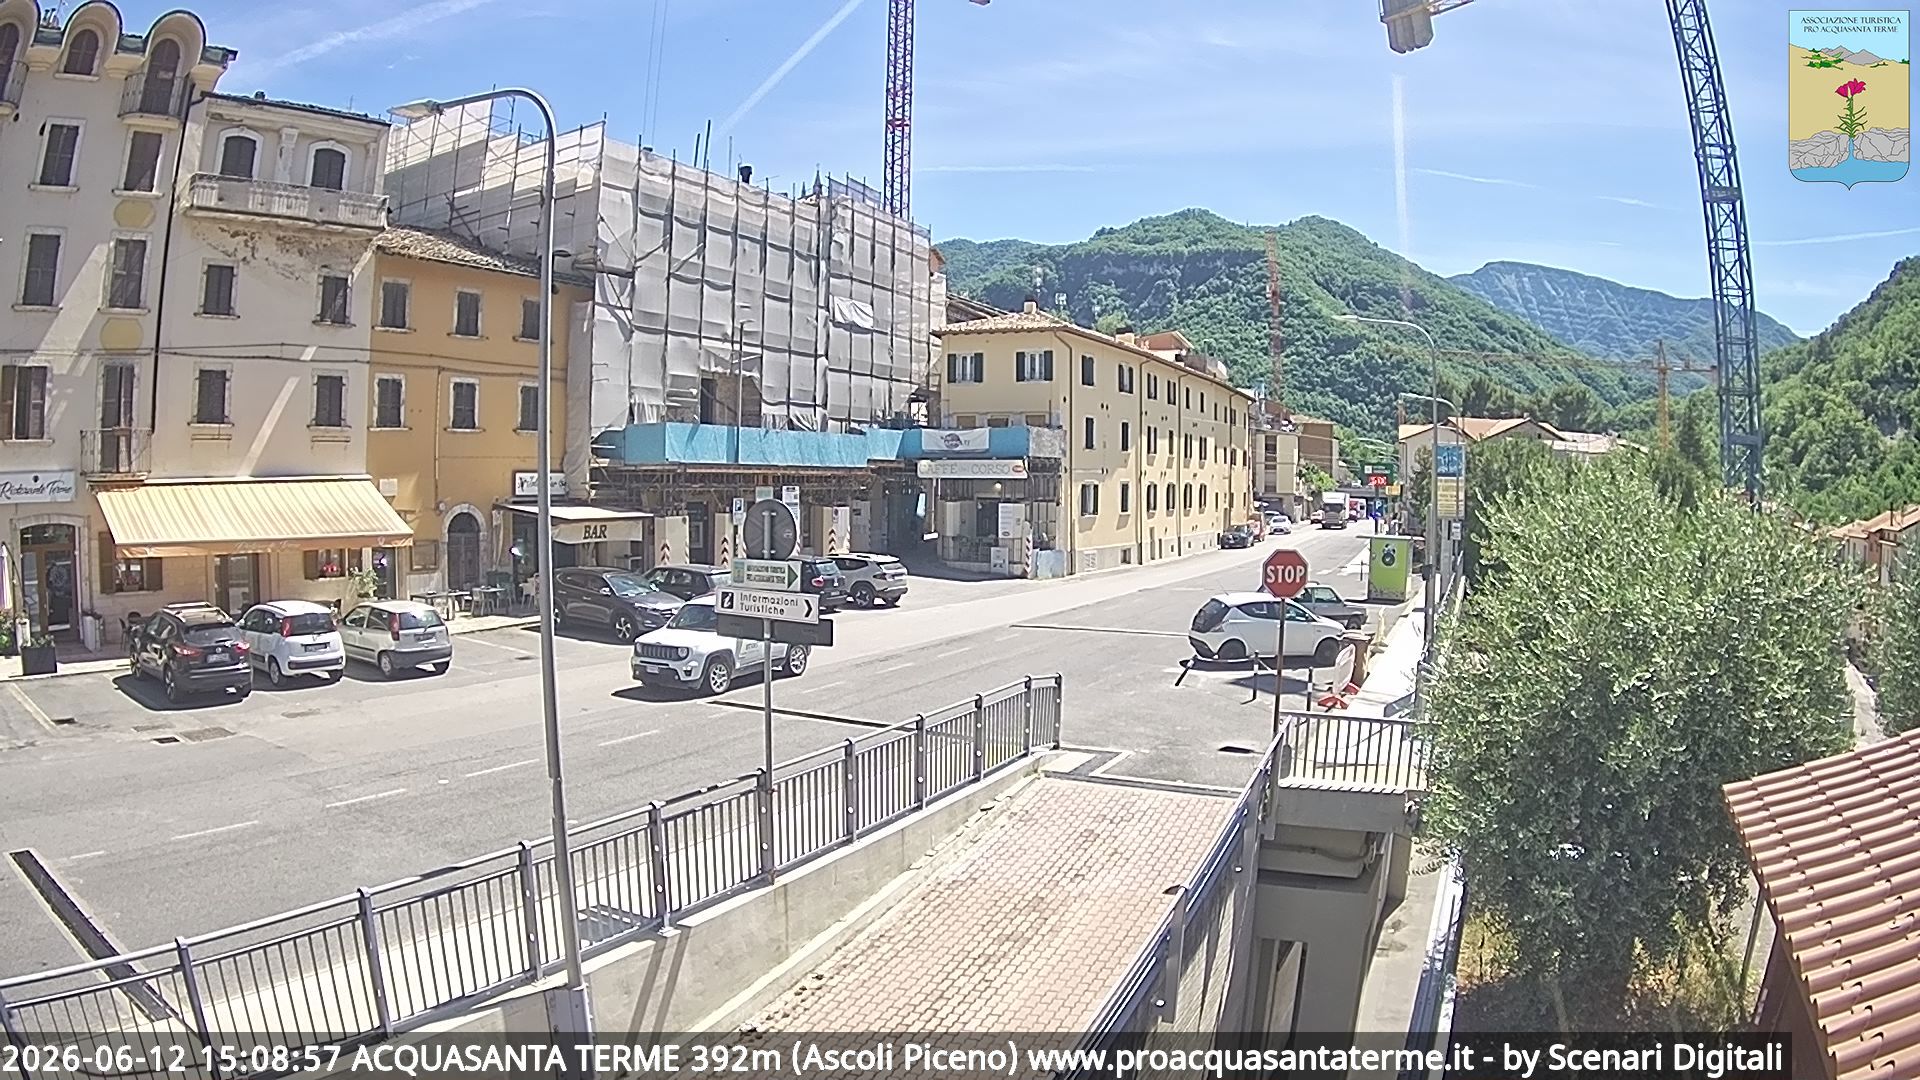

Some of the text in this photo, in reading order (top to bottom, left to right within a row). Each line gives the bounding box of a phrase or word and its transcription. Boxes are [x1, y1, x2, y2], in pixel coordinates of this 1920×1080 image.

[971, 464, 1010, 475] CORSO
[583, 524, 608, 540] BAR
[1266, 565, 1305, 584] STOP
[740, 592, 799, 607] Informazioni
[740, 602, 785, 616] Turistiche
